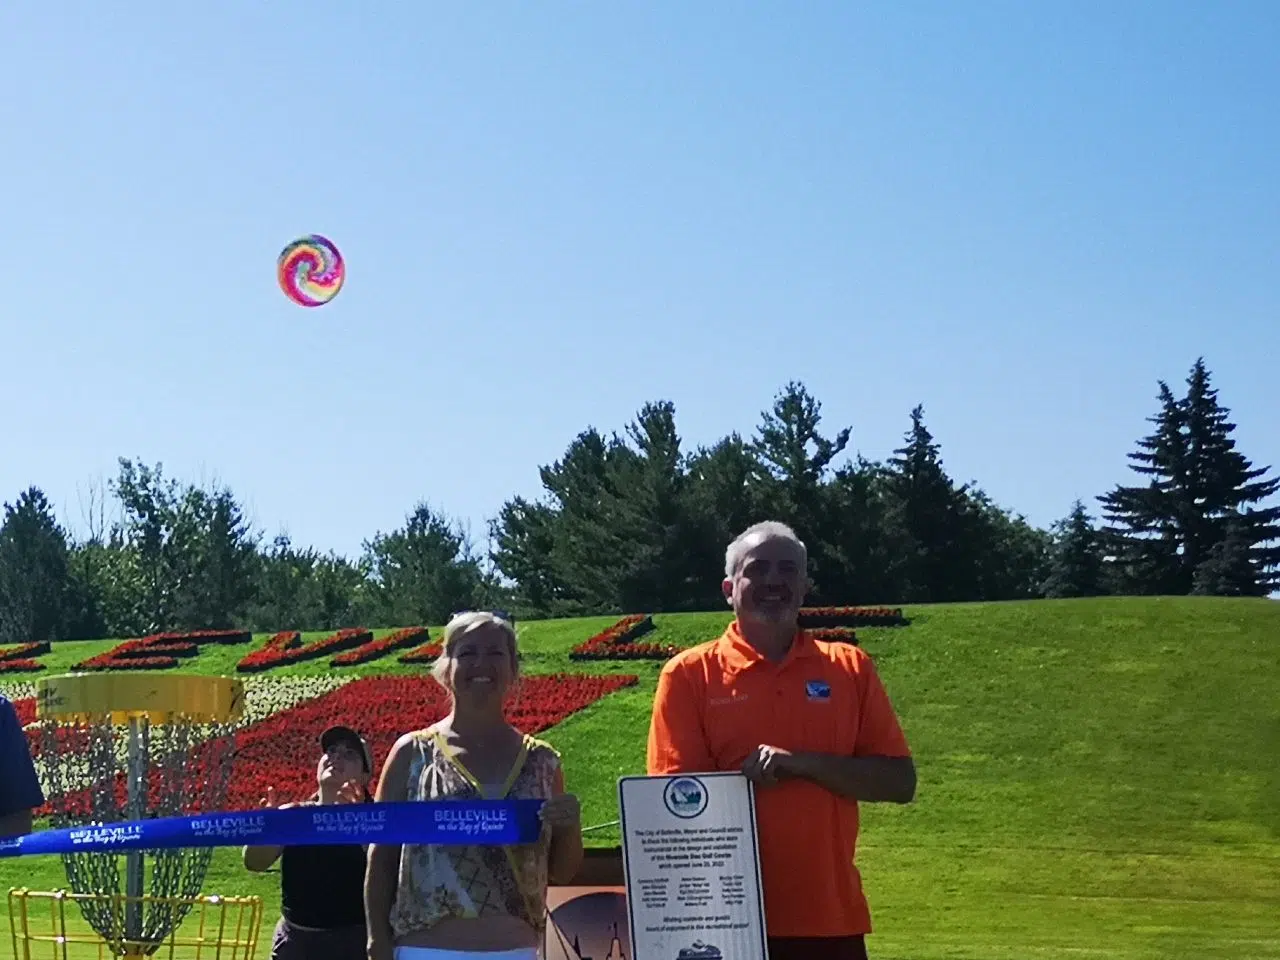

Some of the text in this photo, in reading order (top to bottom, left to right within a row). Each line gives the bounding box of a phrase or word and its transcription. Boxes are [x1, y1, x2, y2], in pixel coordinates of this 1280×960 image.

[312, 811, 387, 824] BELLEVILLE
[434, 809, 507, 821] BELLEVILLE
[191, 816, 265, 829] BELLEVILLE
[70, 825, 144, 839] BELLEVILLE
